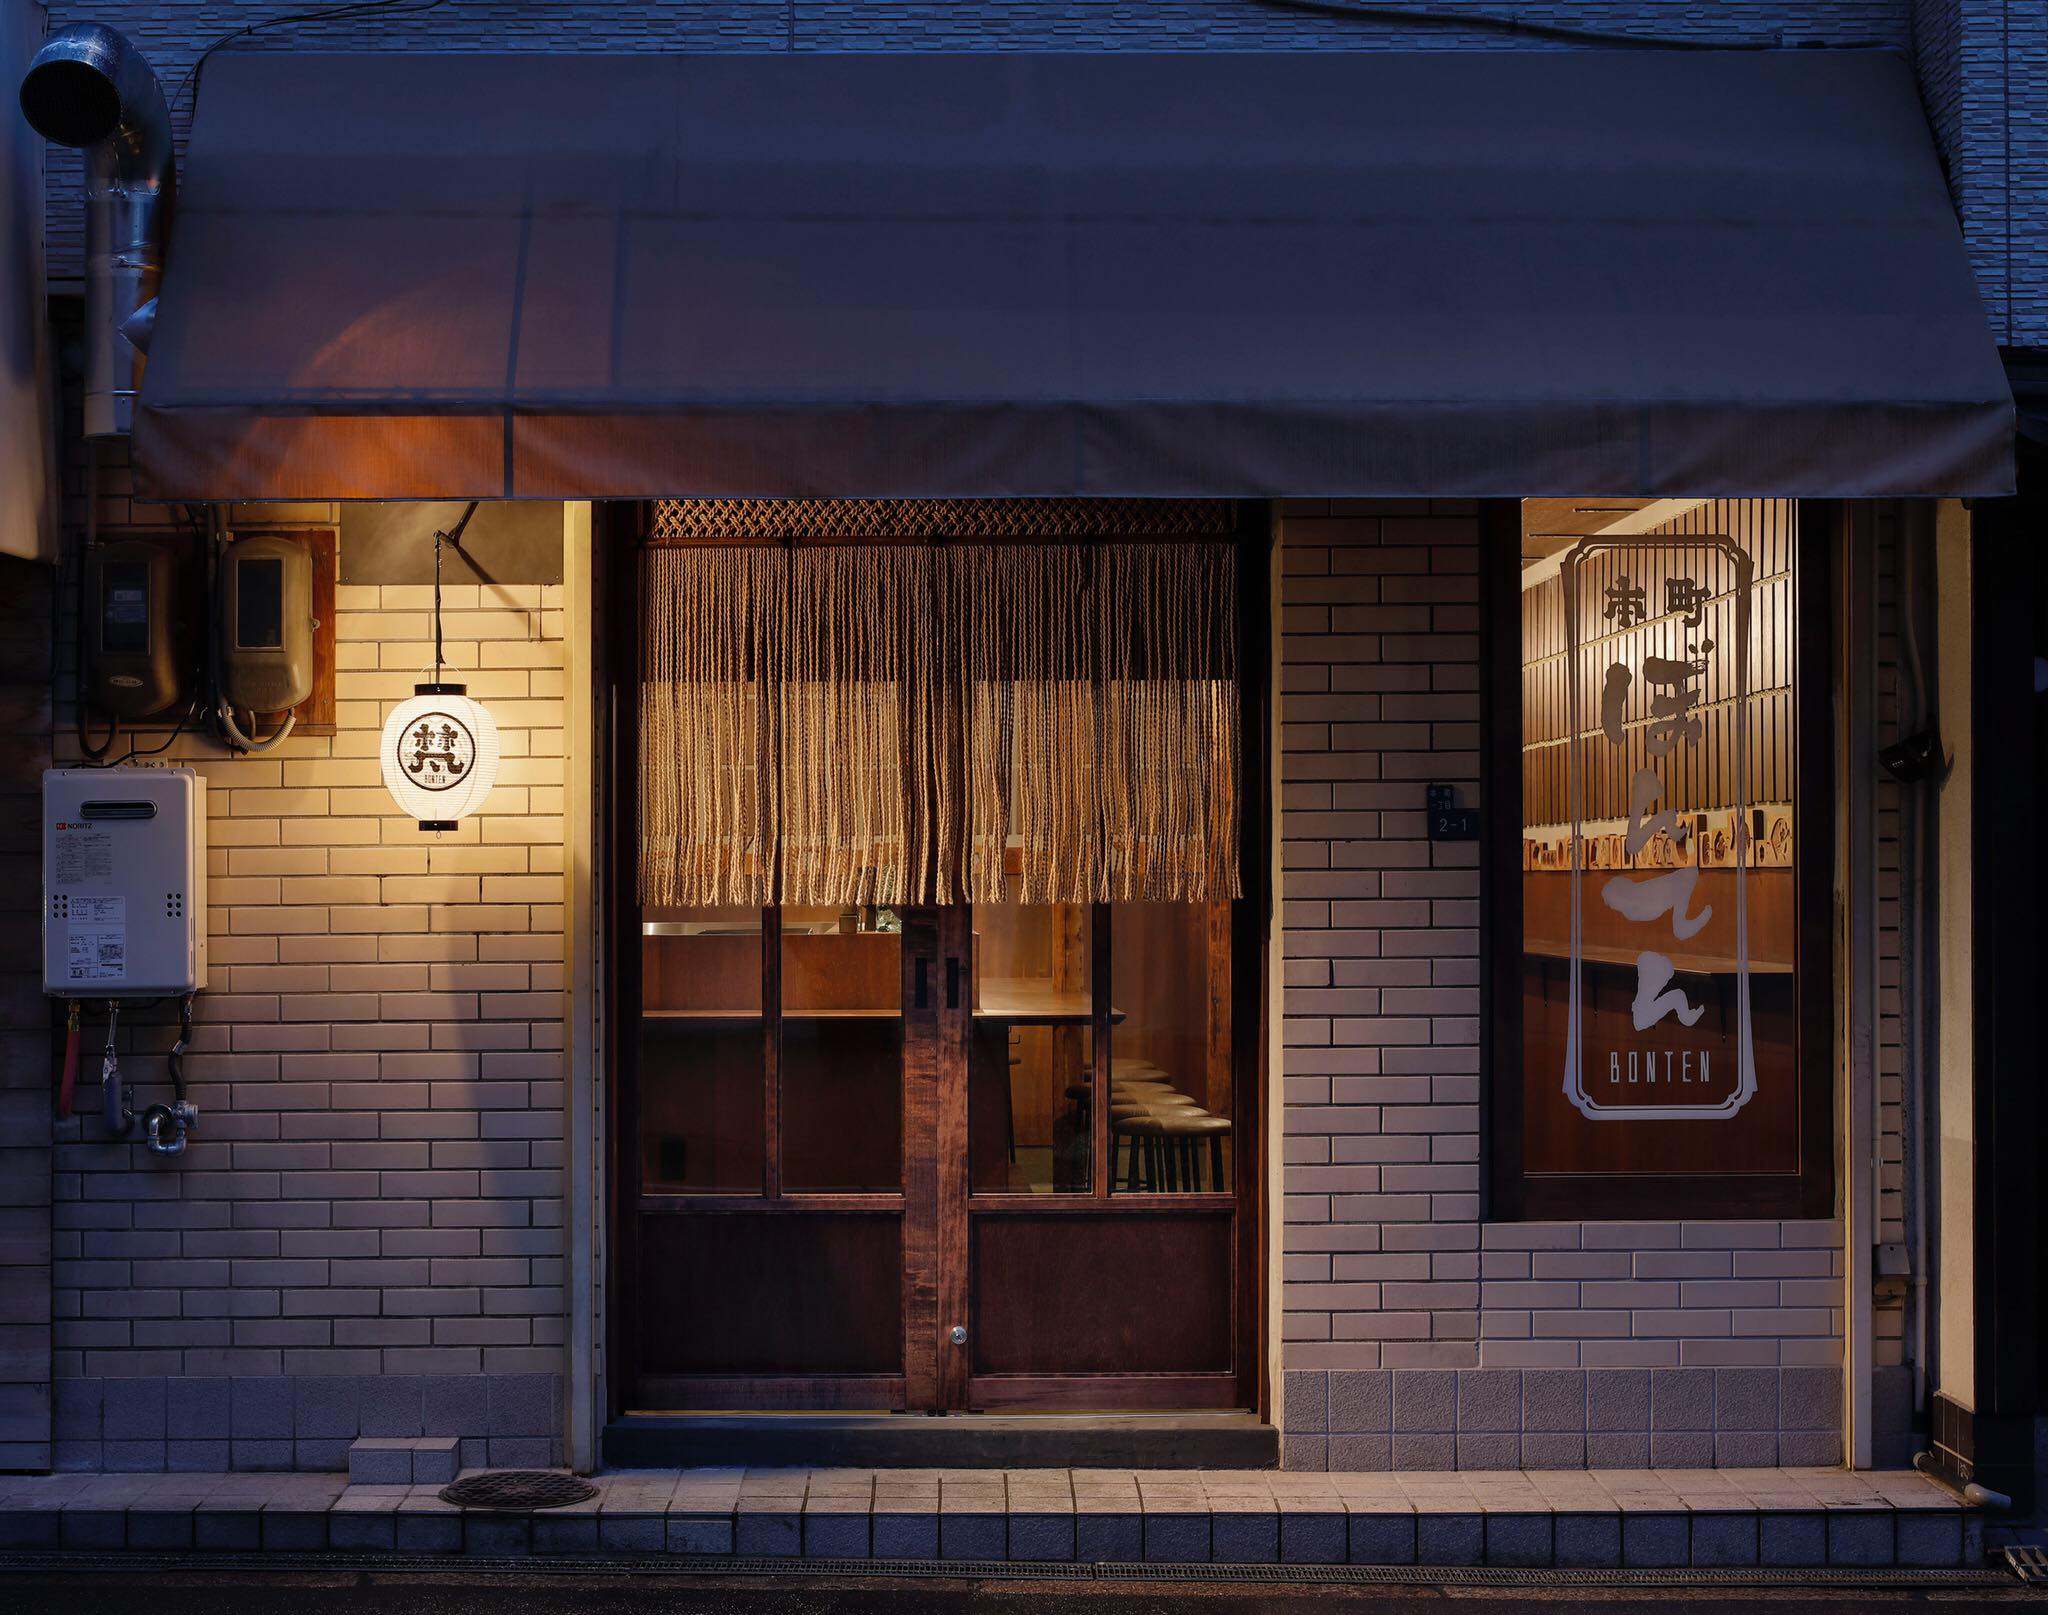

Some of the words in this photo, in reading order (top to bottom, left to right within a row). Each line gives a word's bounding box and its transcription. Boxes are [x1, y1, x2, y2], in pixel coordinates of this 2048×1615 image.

[1603, 575, 1711, 628] 本町
[424, 774, 446, 784] BONTEN
[67, 822, 93, 830] NORITZ
[1439, 817, 1466, 832] 2-1
[1610, 1051, 1710, 1083] BONTEN
